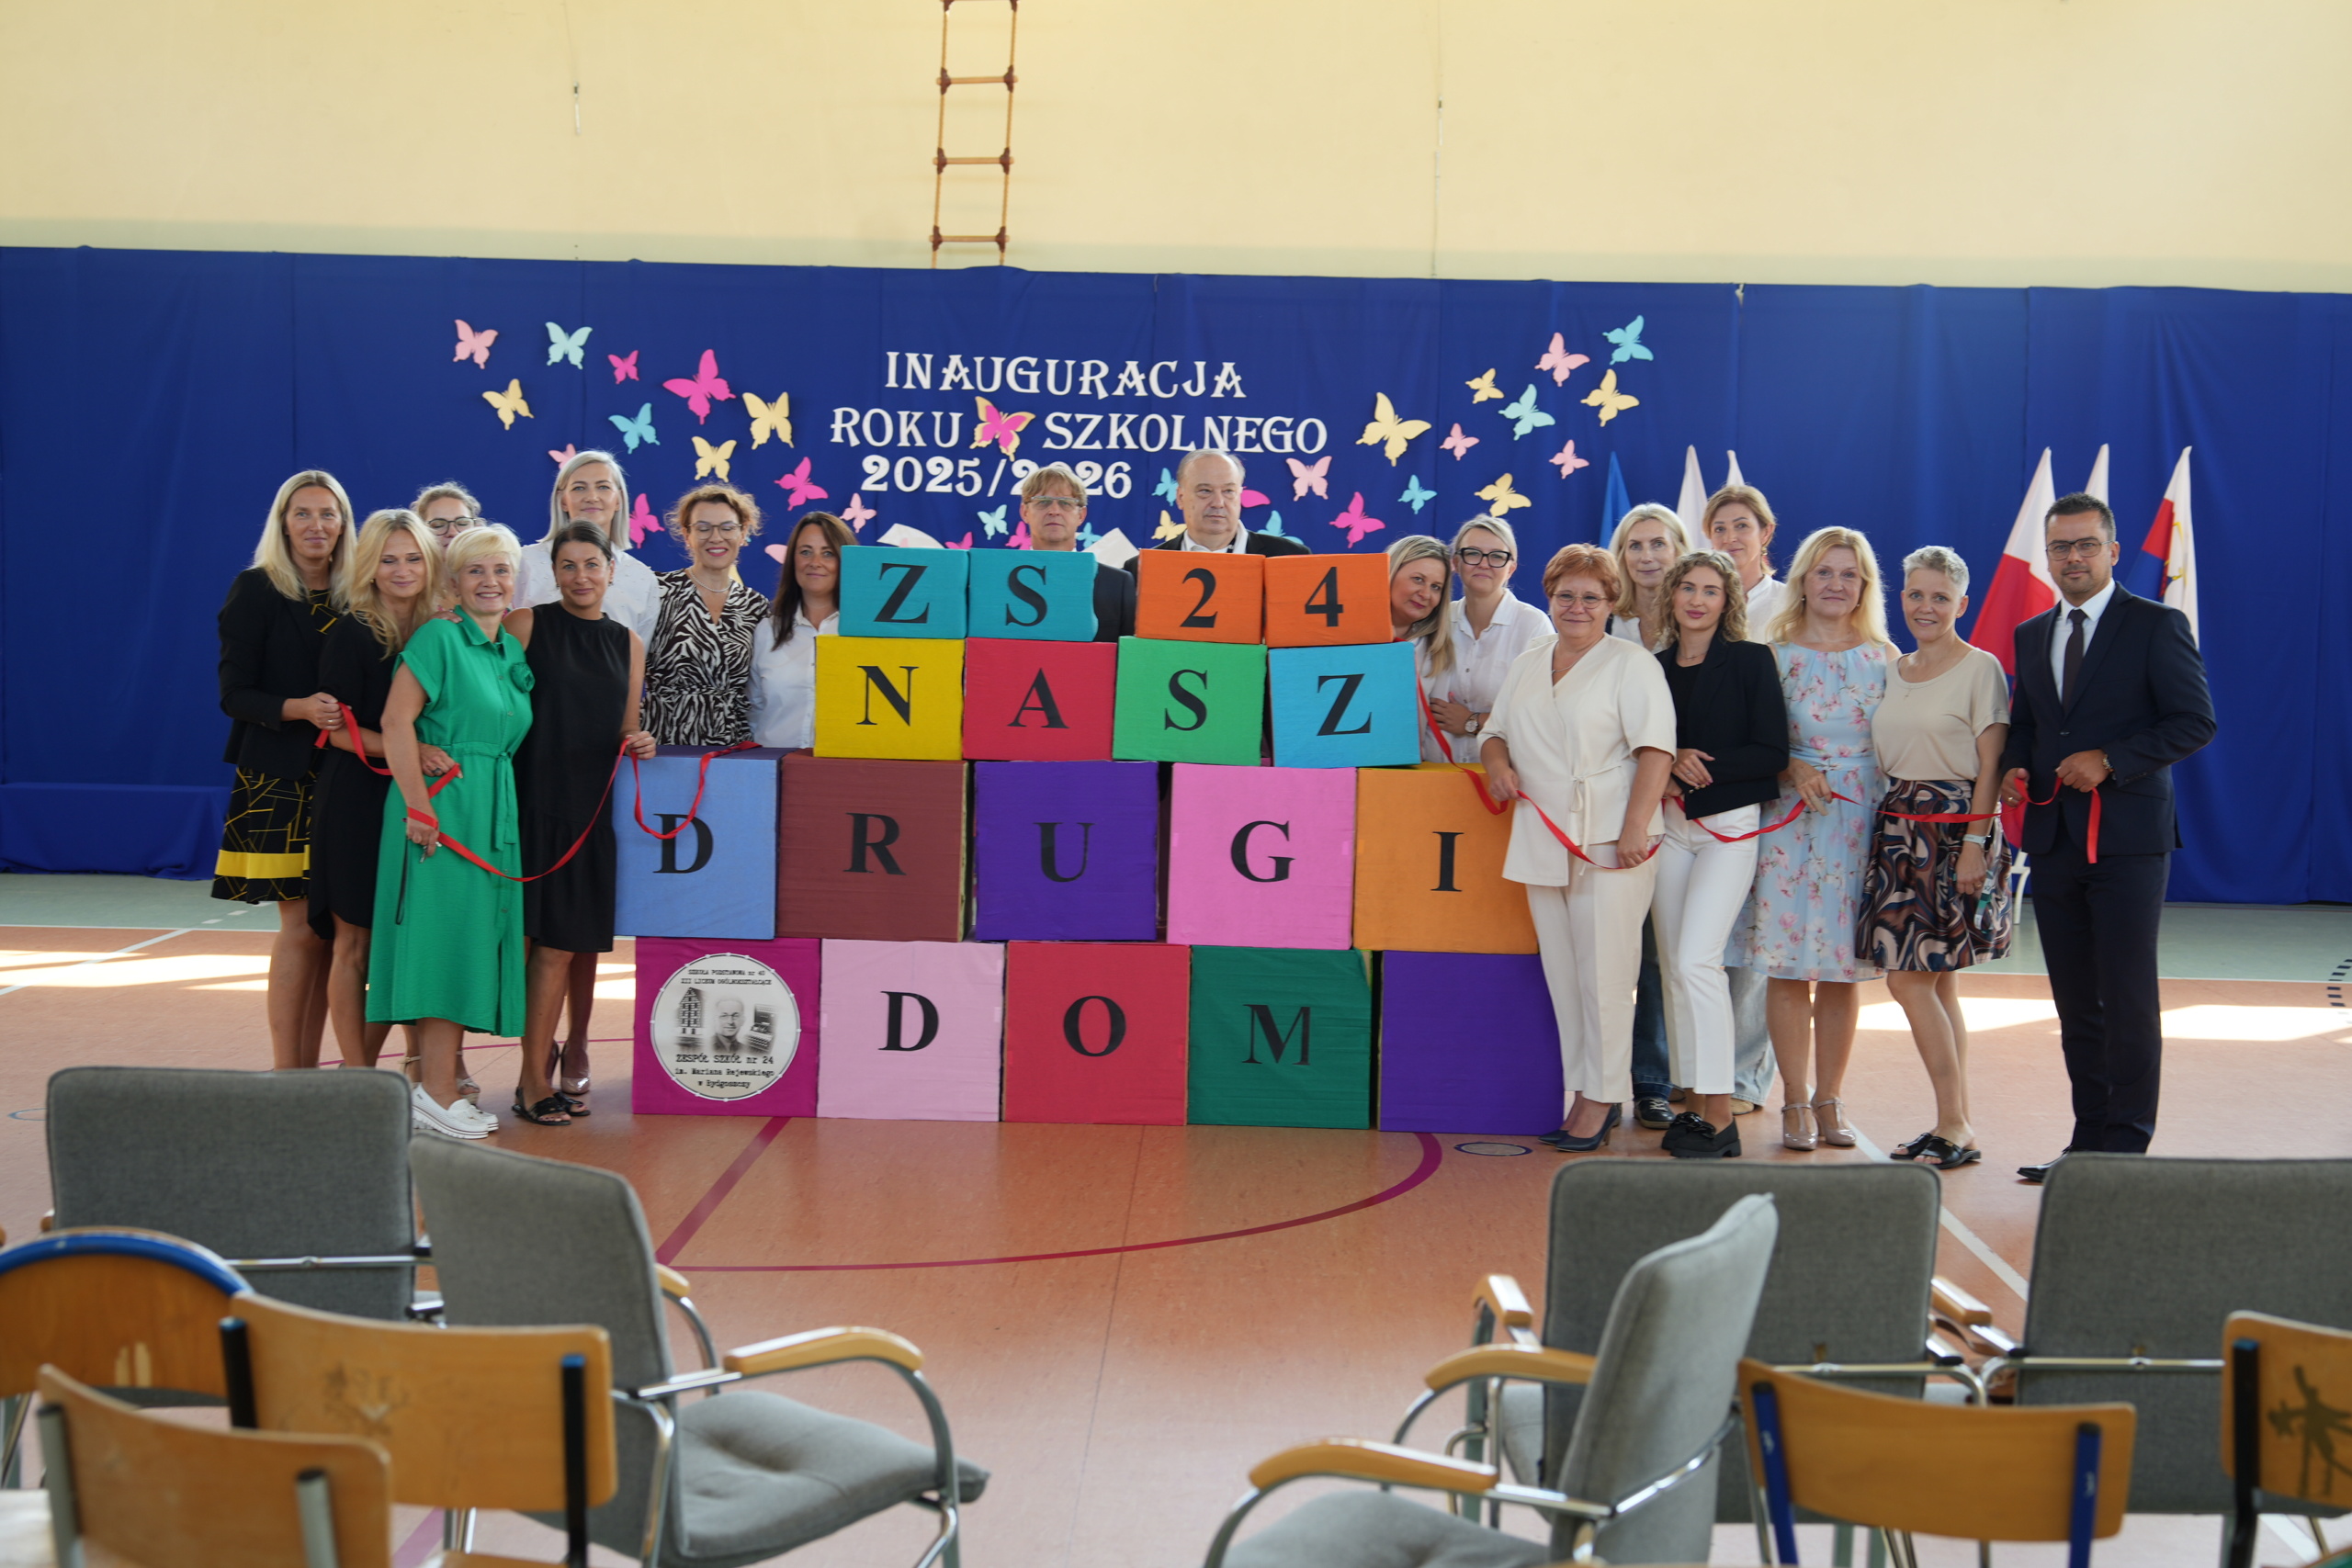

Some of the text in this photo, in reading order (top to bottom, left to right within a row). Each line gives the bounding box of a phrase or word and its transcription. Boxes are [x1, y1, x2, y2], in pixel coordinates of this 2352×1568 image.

[885, 351, 1247, 400] INAUGURACJA
[830, 407, 1329, 454] ROKU SZKOLNEGO
[861, 454, 1132, 499] 2025/226
[874, 563, 1344, 628] ZS 24
[856, 665, 1373, 736] NASZ
[653, 813, 1464, 892] DRUGI
[878, 991, 1312, 1066] DOM
[676, 1052, 709, 1063] ZESPÓŁ
[714, 1054, 742, 1064] SZKÓŁ
[762, 1055, 774, 1065] 24
[691, 1067, 722, 1076] Mariana
